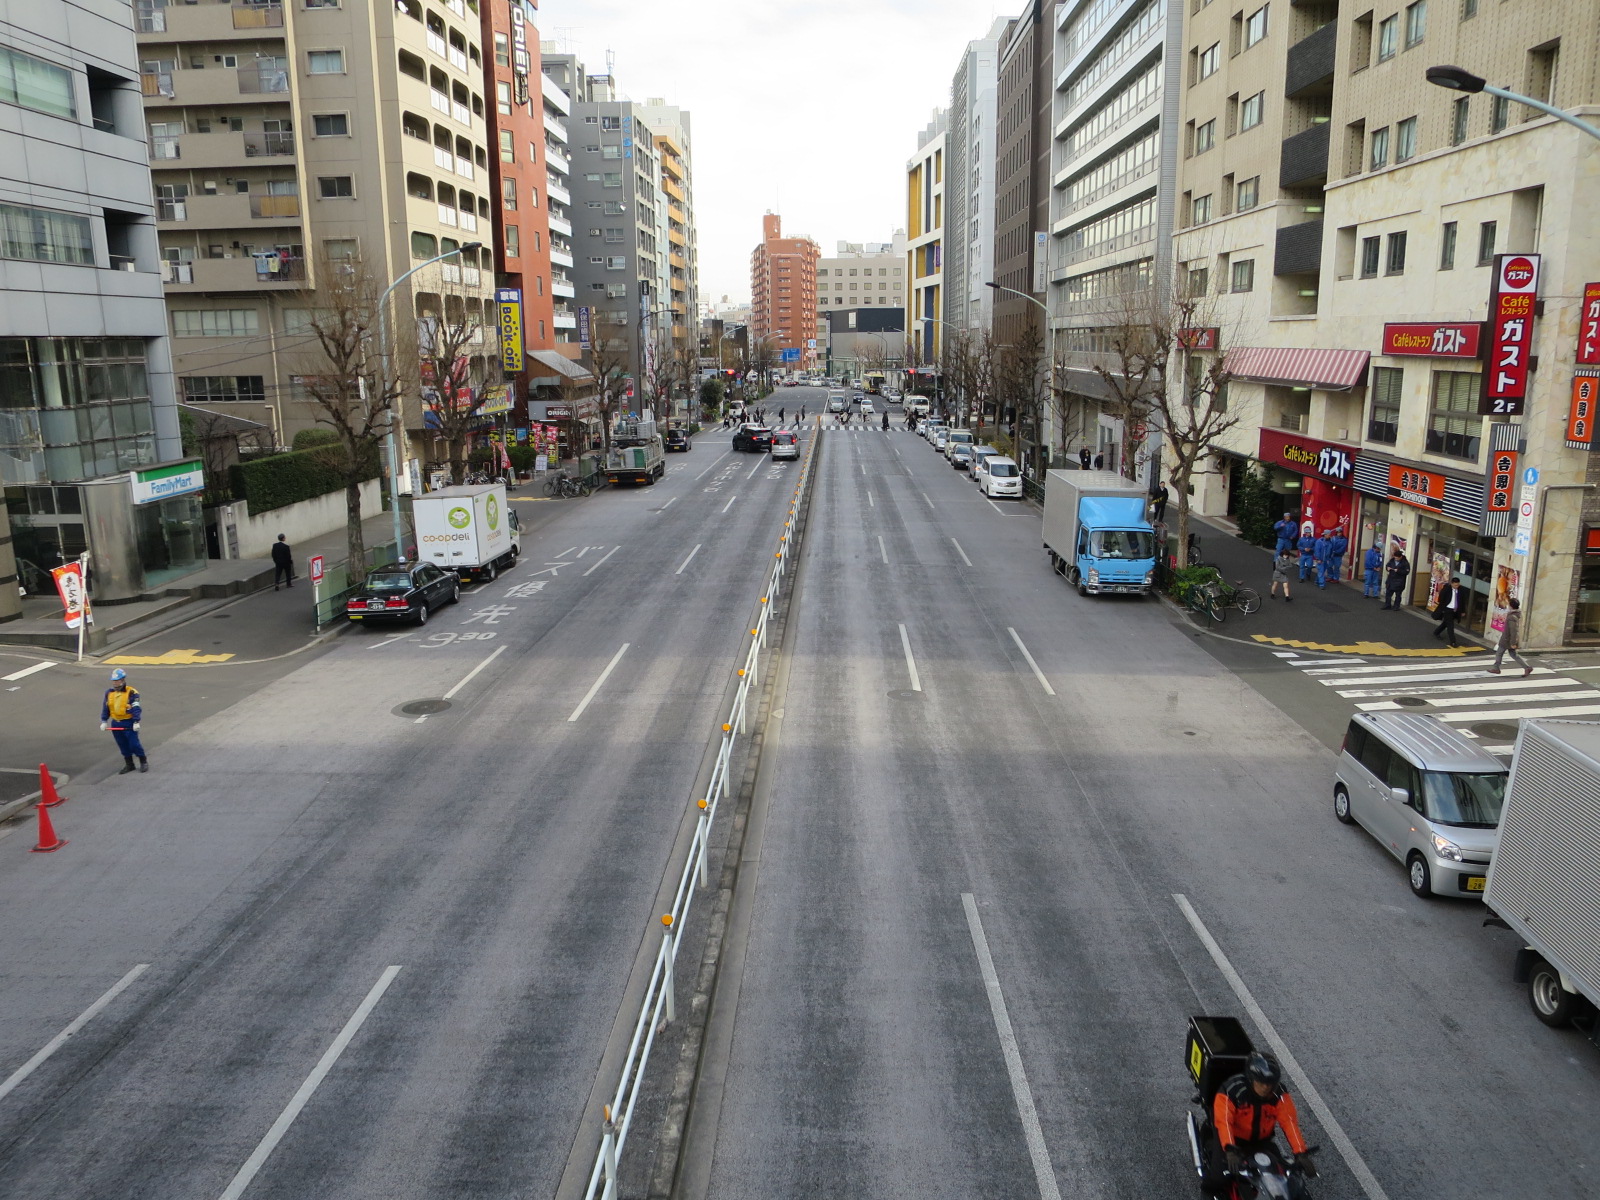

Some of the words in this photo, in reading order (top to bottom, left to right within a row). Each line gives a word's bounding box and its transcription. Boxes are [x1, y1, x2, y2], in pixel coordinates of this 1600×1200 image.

[1507, 271, 1531, 280] ガスト
[1501, 296, 1530, 307] Café
[1431, 328, 1467, 353] ガスト
[1584, 300, 1600, 359] ガスト
[1497, 319, 1524, 393] ガスト
[1492, 399, 1516, 413] 2F
[1318, 447, 1351, 480] ガスト
[150, 476, 192, 494] FamilyMart
[1401, 471, 1429, 493] 吉野家
[1493, 456, 1512, 507] 吉野家
